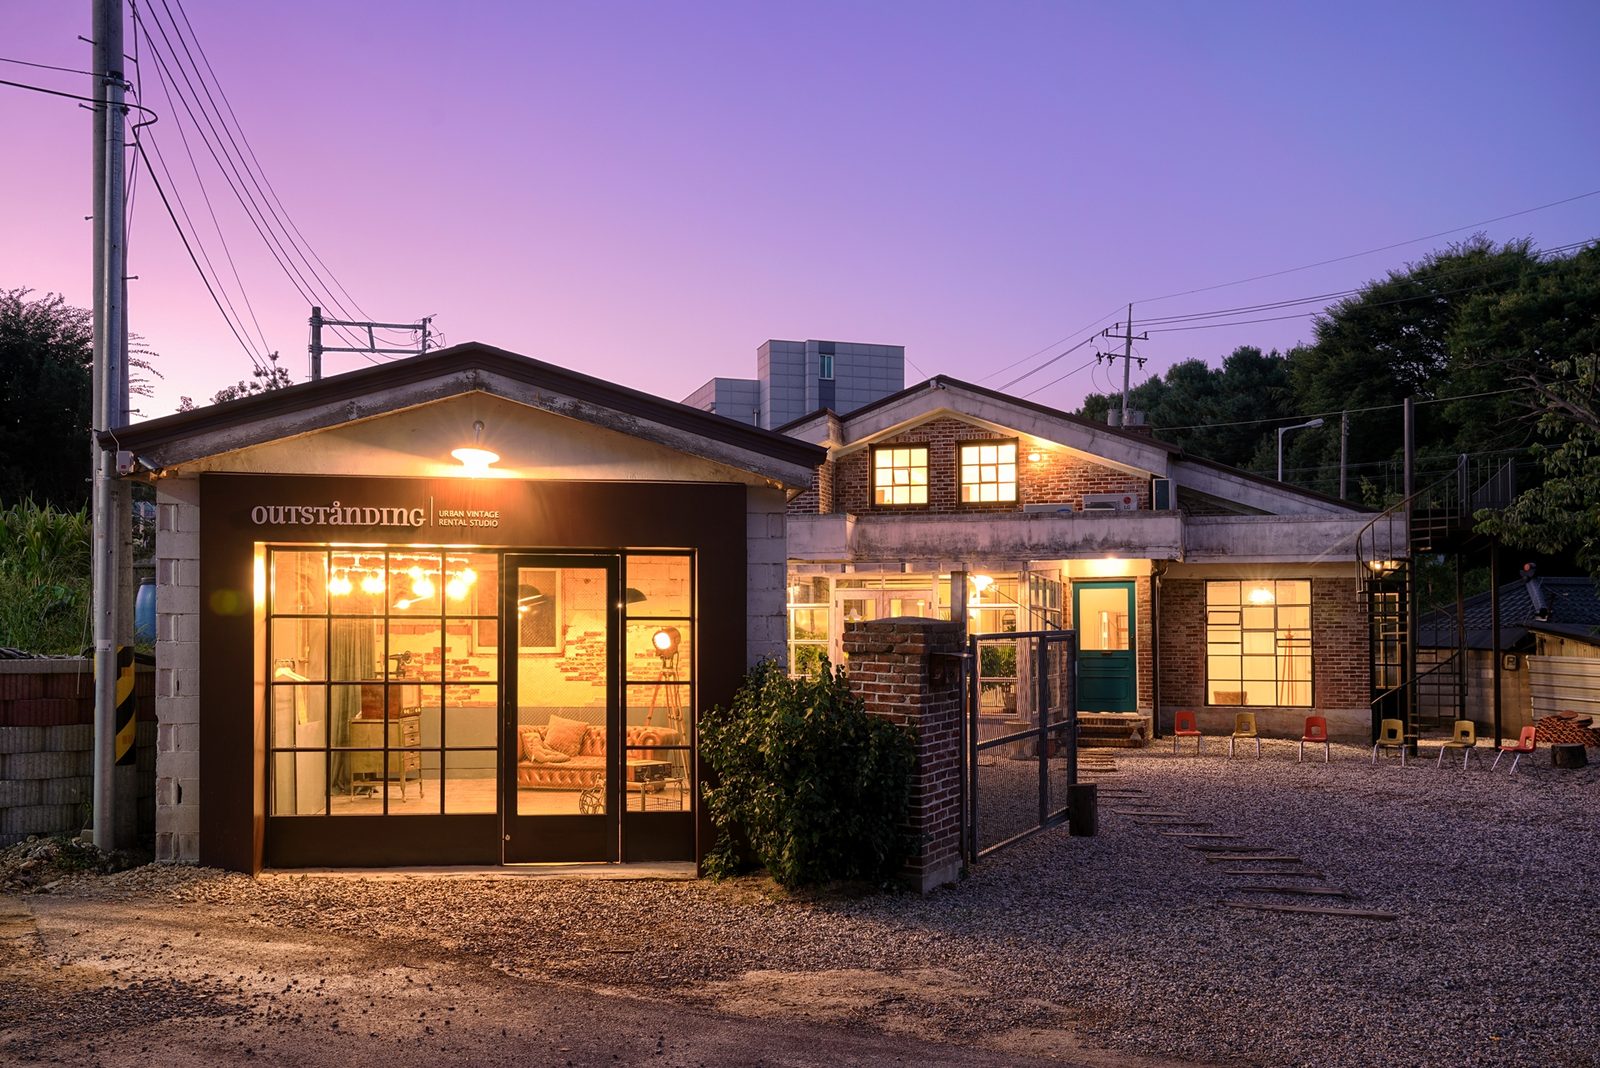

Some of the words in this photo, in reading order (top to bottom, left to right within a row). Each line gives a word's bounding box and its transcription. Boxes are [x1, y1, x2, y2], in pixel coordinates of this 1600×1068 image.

[438, 510, 464, 518] URBAN
[466, 510, 500, 518] VINTAGE
[469, 519, 499, 527] STUDIO
